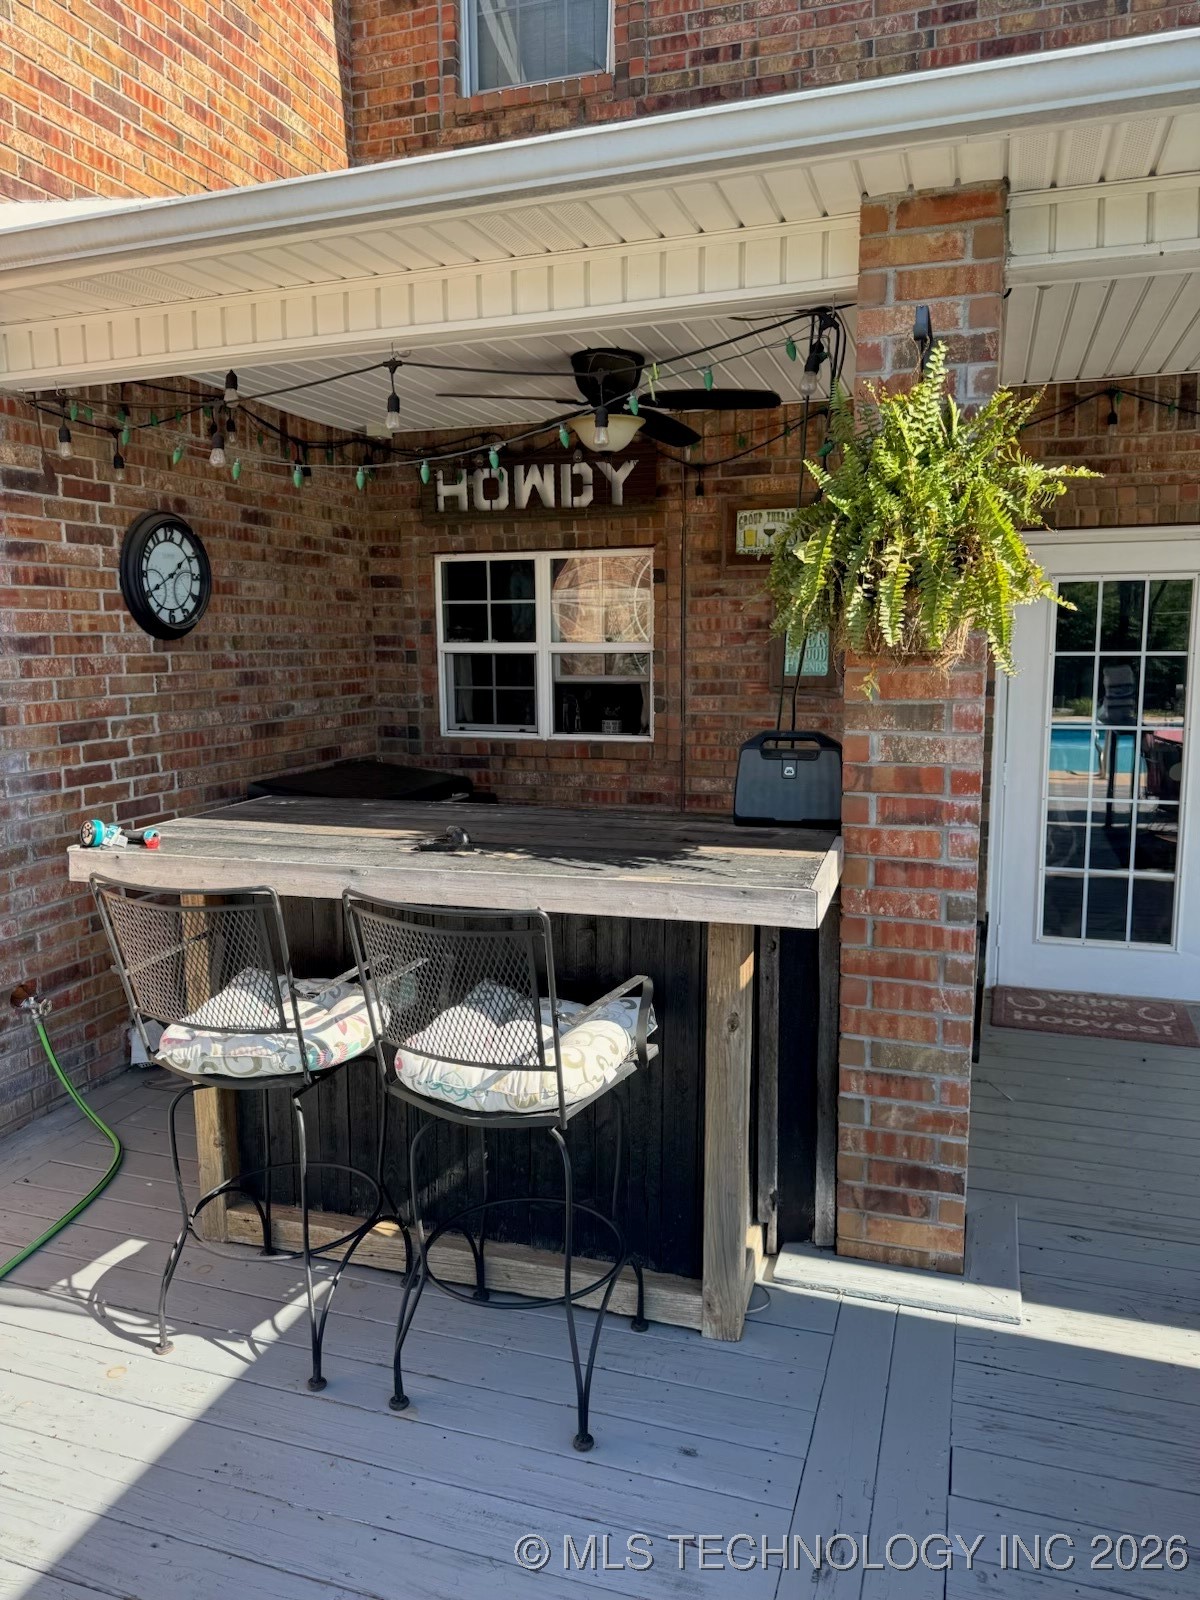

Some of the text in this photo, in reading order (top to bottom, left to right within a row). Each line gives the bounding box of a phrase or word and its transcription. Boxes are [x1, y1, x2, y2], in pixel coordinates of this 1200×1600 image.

[436, 459, 640, 513] HOWDY
[738, 510, 797, 526] GROUP THERA
[784, 657, 828, 673] FENDS
[1012, 1009, 1175, 1036] hooves!
